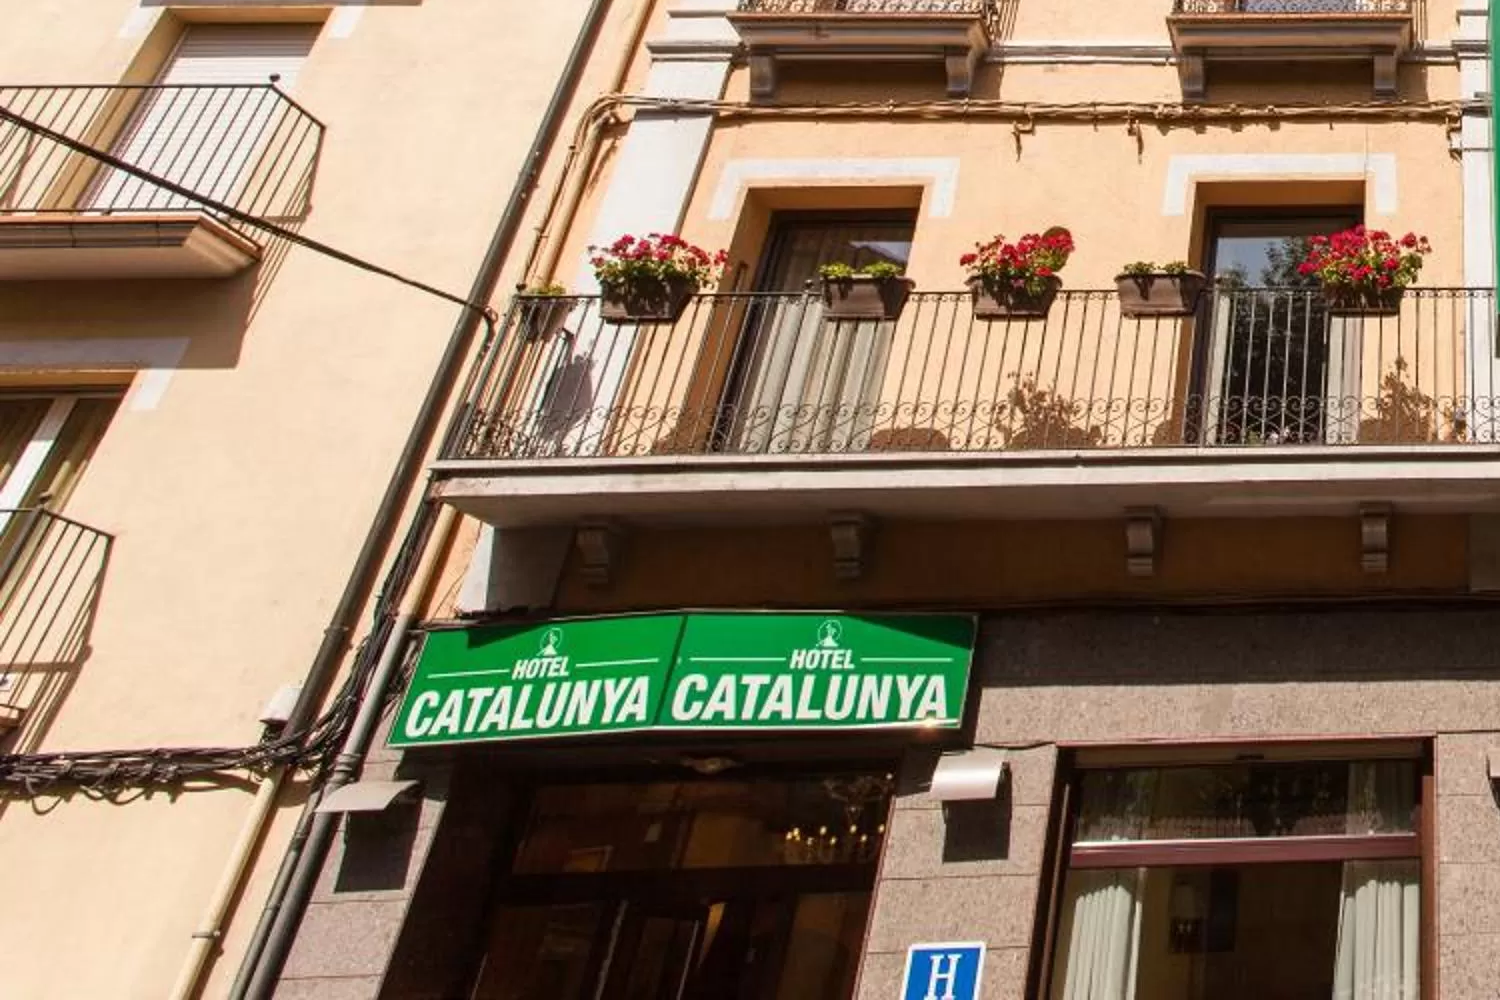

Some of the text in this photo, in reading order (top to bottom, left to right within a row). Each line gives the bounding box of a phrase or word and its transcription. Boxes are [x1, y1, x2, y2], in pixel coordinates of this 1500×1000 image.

[512, 656, 569, 680] HOTEL
[789, 649, 855, 669] HOTEL
[405, 676, 650, 738] CATALUNYA
[671, 674, 948, 720] CATALUNYA
[924, 954, 962, 1000] H
